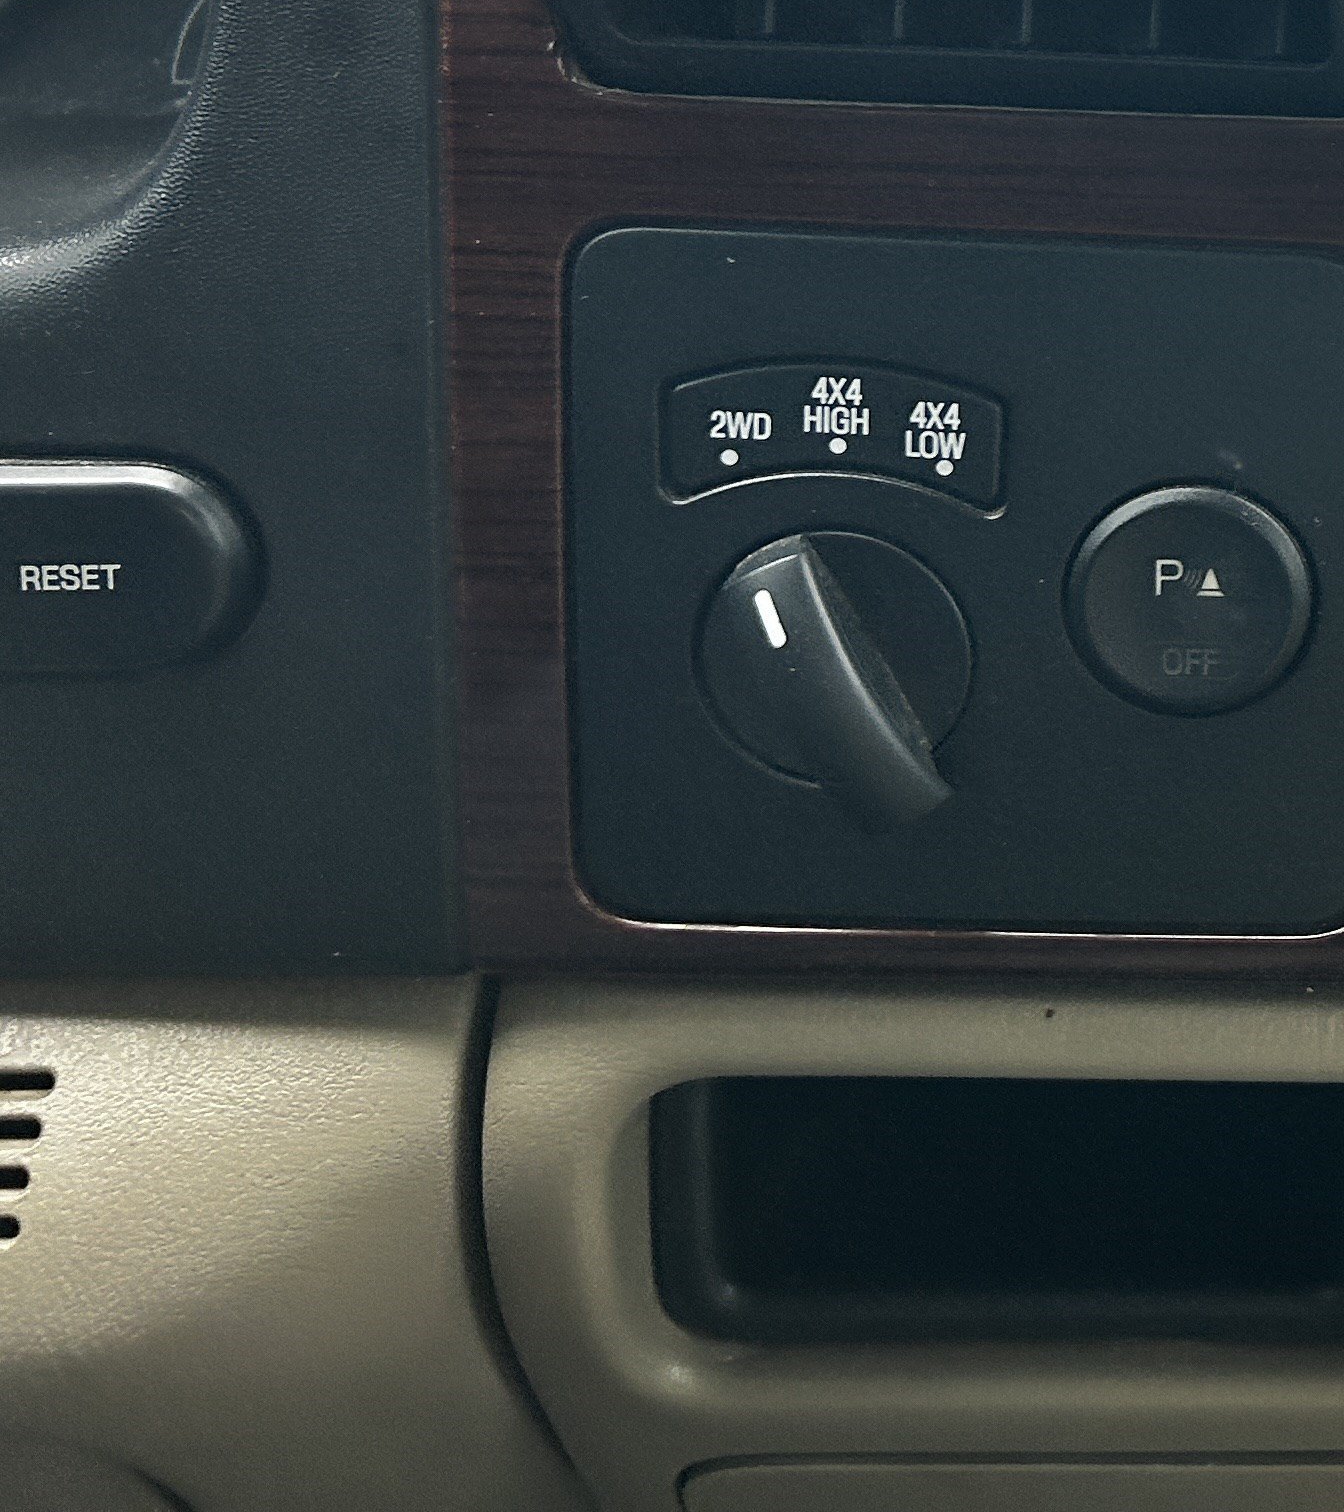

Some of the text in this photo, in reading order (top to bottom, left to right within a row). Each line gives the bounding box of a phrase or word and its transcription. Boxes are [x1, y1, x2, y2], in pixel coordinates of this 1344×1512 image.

[811, 376, 863, 405] 4X4
[709, 410, 772, 440] 2WD
[803, 406, 870, 437] HIGH
[909, 401, 962, 431] 4X4
[904, 430, 967, 461] LOW
[20, 563, 121, 591] RESET
[1161, 648, 1219, 676] OFF
